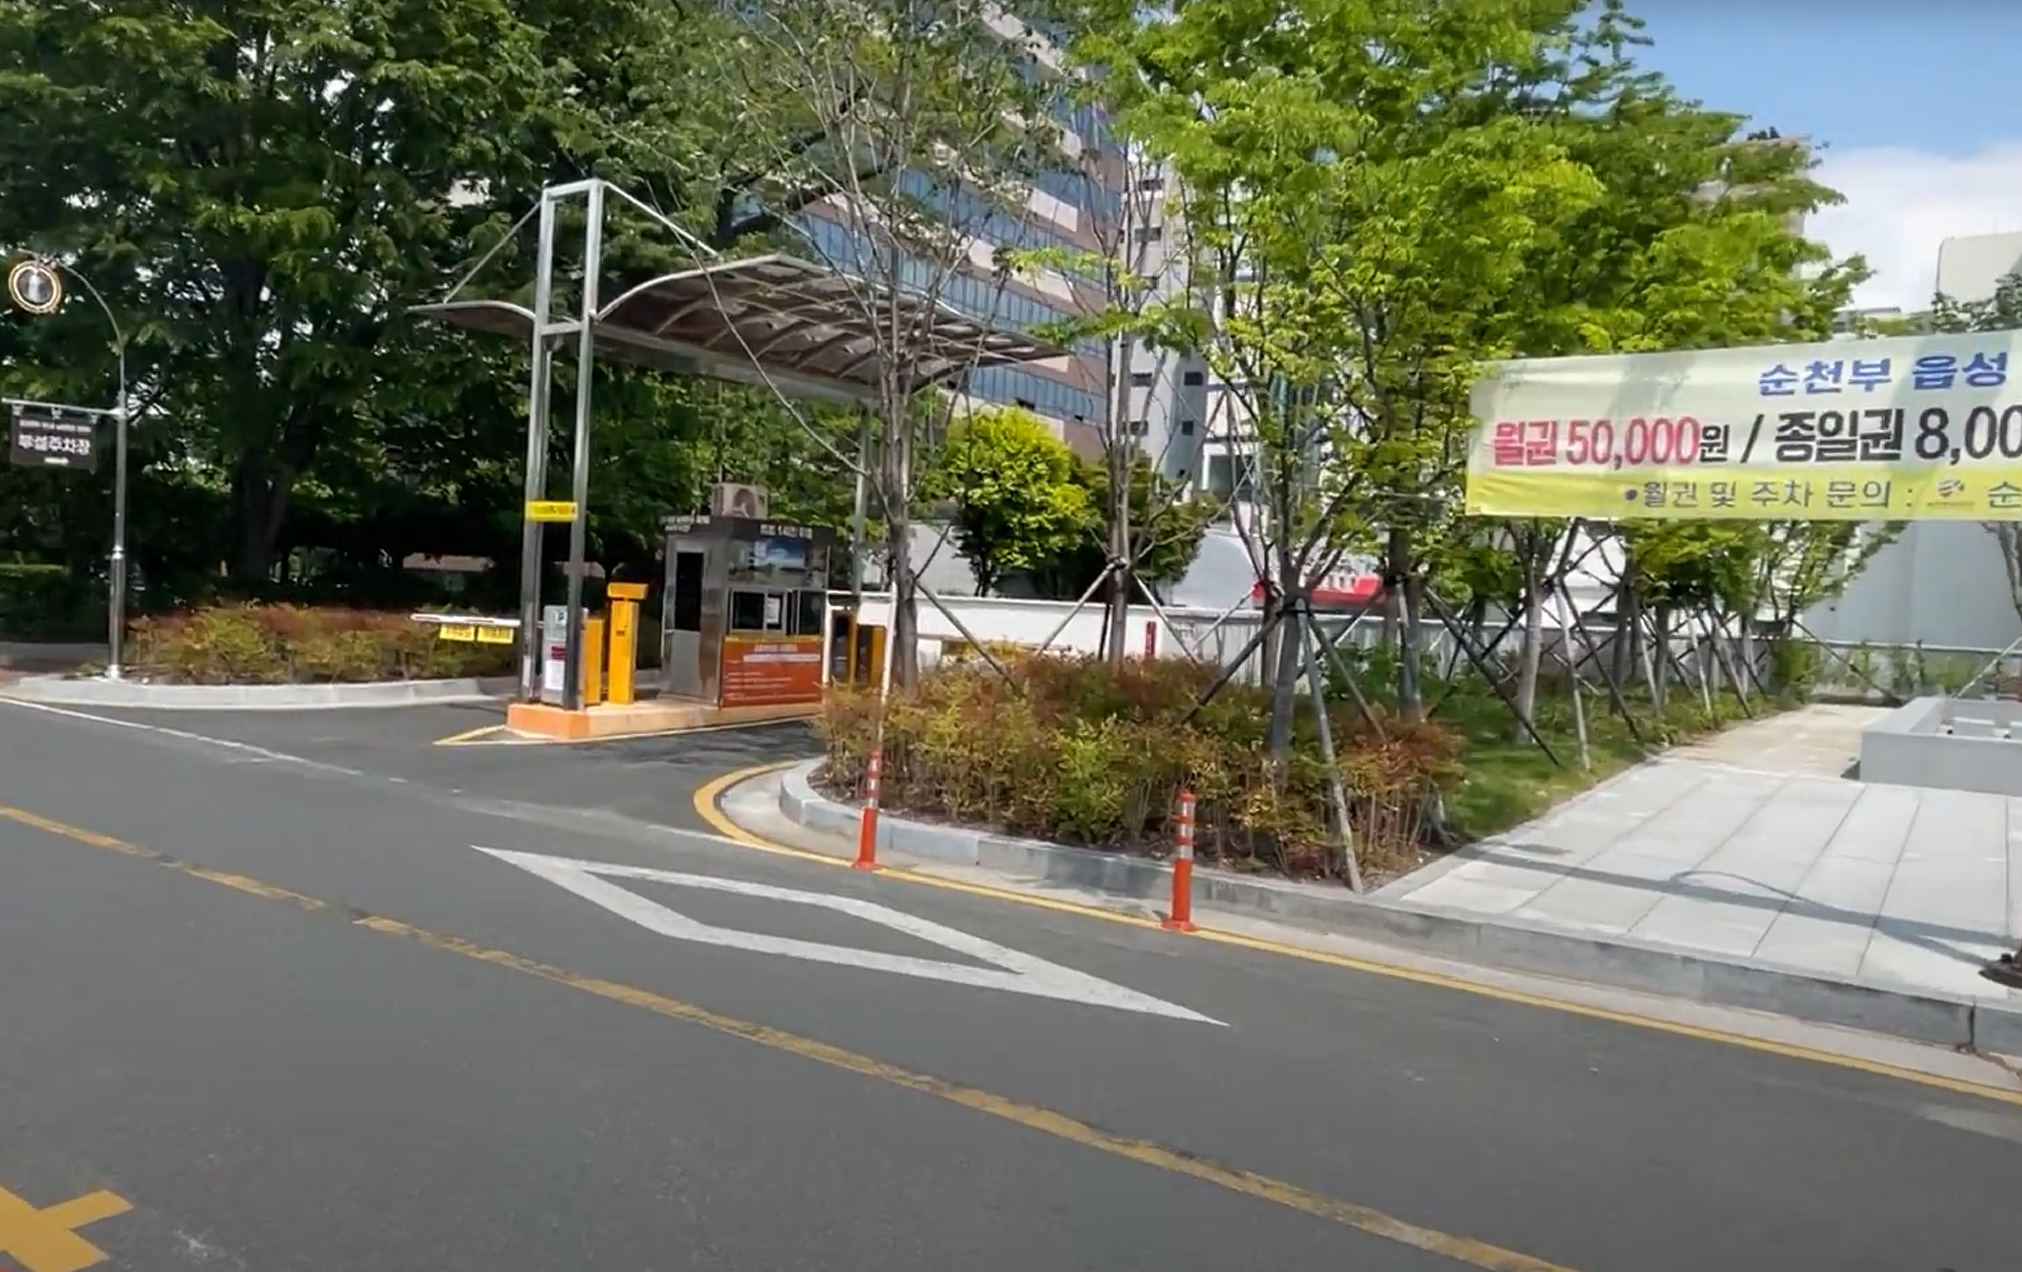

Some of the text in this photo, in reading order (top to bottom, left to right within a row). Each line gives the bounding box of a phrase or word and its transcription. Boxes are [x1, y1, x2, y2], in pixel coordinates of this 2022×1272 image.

[1759, 351, 2008, 396] 순천부 읍성
[1494, 420, 1557, 466] 월권
[1566, 416, 1730, 470] 50,000원
[1775, 408, 1905, 463] 종일권
[1643, 481, 1698, 508] 월권
[1710, 481, 1737, 508] 및
[1751, 480, 1813, 508] 주차
[1827, 481, 1891, 508] 문의
